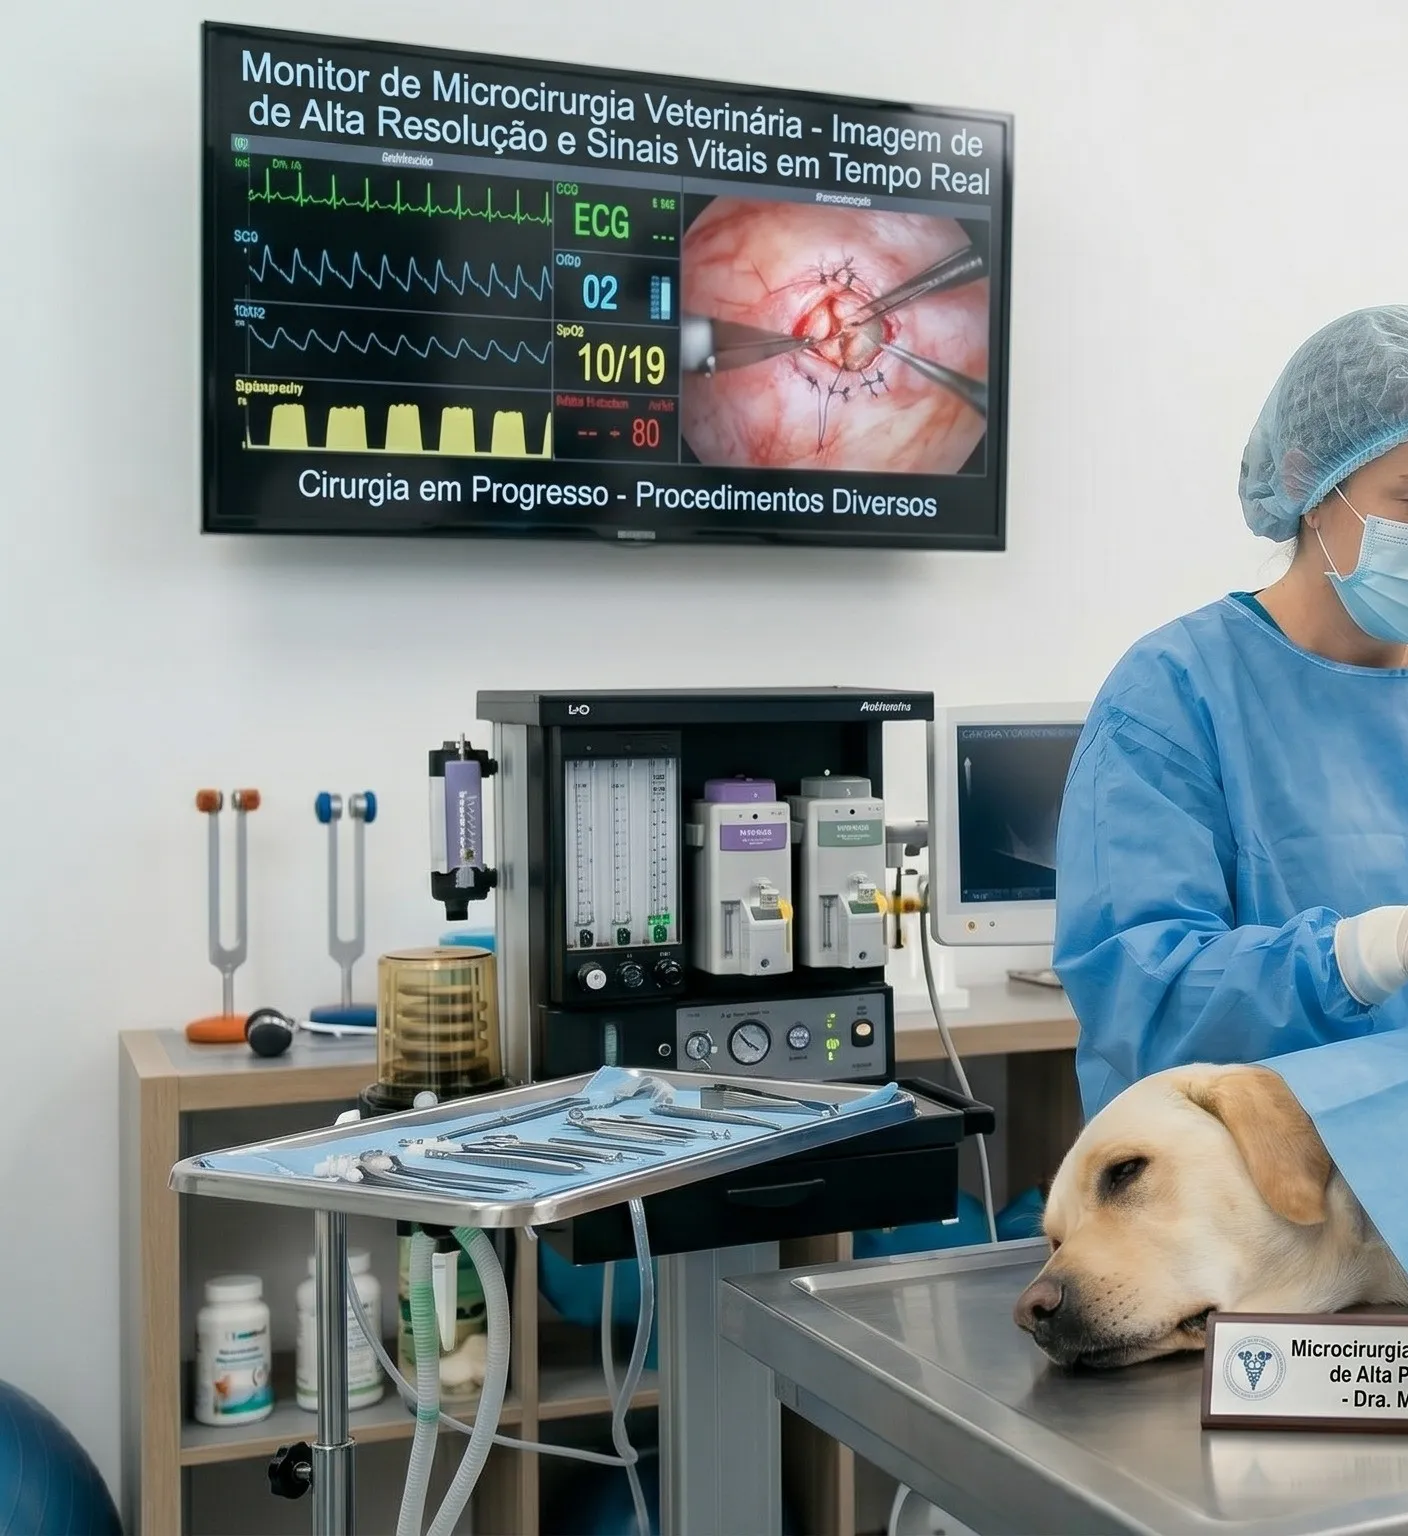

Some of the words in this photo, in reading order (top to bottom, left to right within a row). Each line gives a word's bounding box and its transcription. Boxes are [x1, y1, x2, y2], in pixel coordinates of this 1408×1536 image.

[242, 50, 370, 93] Monitor
[380, 66, 421, 99] de
[433, 70, 635, 125] Microcirurgia
[644, 93, 802, 139] Veterinária
[832, 114, 941, 156] Imagem
[950, 128, 983, 157] de
[249, 94, 291, 127] de
[299, 99, 365, 135] Alta
[377, 105, 547, 155] Resolução
[557, 132, 577, 155] e
[587, 127, 679, 165] Sinais
[687, 137, 768, 174] Vitais
[776, 154, 820, 179] em
[828, 152, 922, 193] Tempo
[931, 162, 990, 195] Real
[575, 202, 630, 238] ECG
[578, 342, 665, 385] 10/19
[632, 418, 659, 447] 80
[298, 469, 409, 507] Cirurgia
[419, 479, 461, 502] em
[472, 475, 609, 511] Progresso
[636, 481, 824, 514] Procedimentos
[832, 488, 938, 517] Diversos
[1329, 1365, 1352, 1383] de
[1357, 1365, 1392, 1384] Alta
[1354, 1390, 1391, 1408] Dra.
